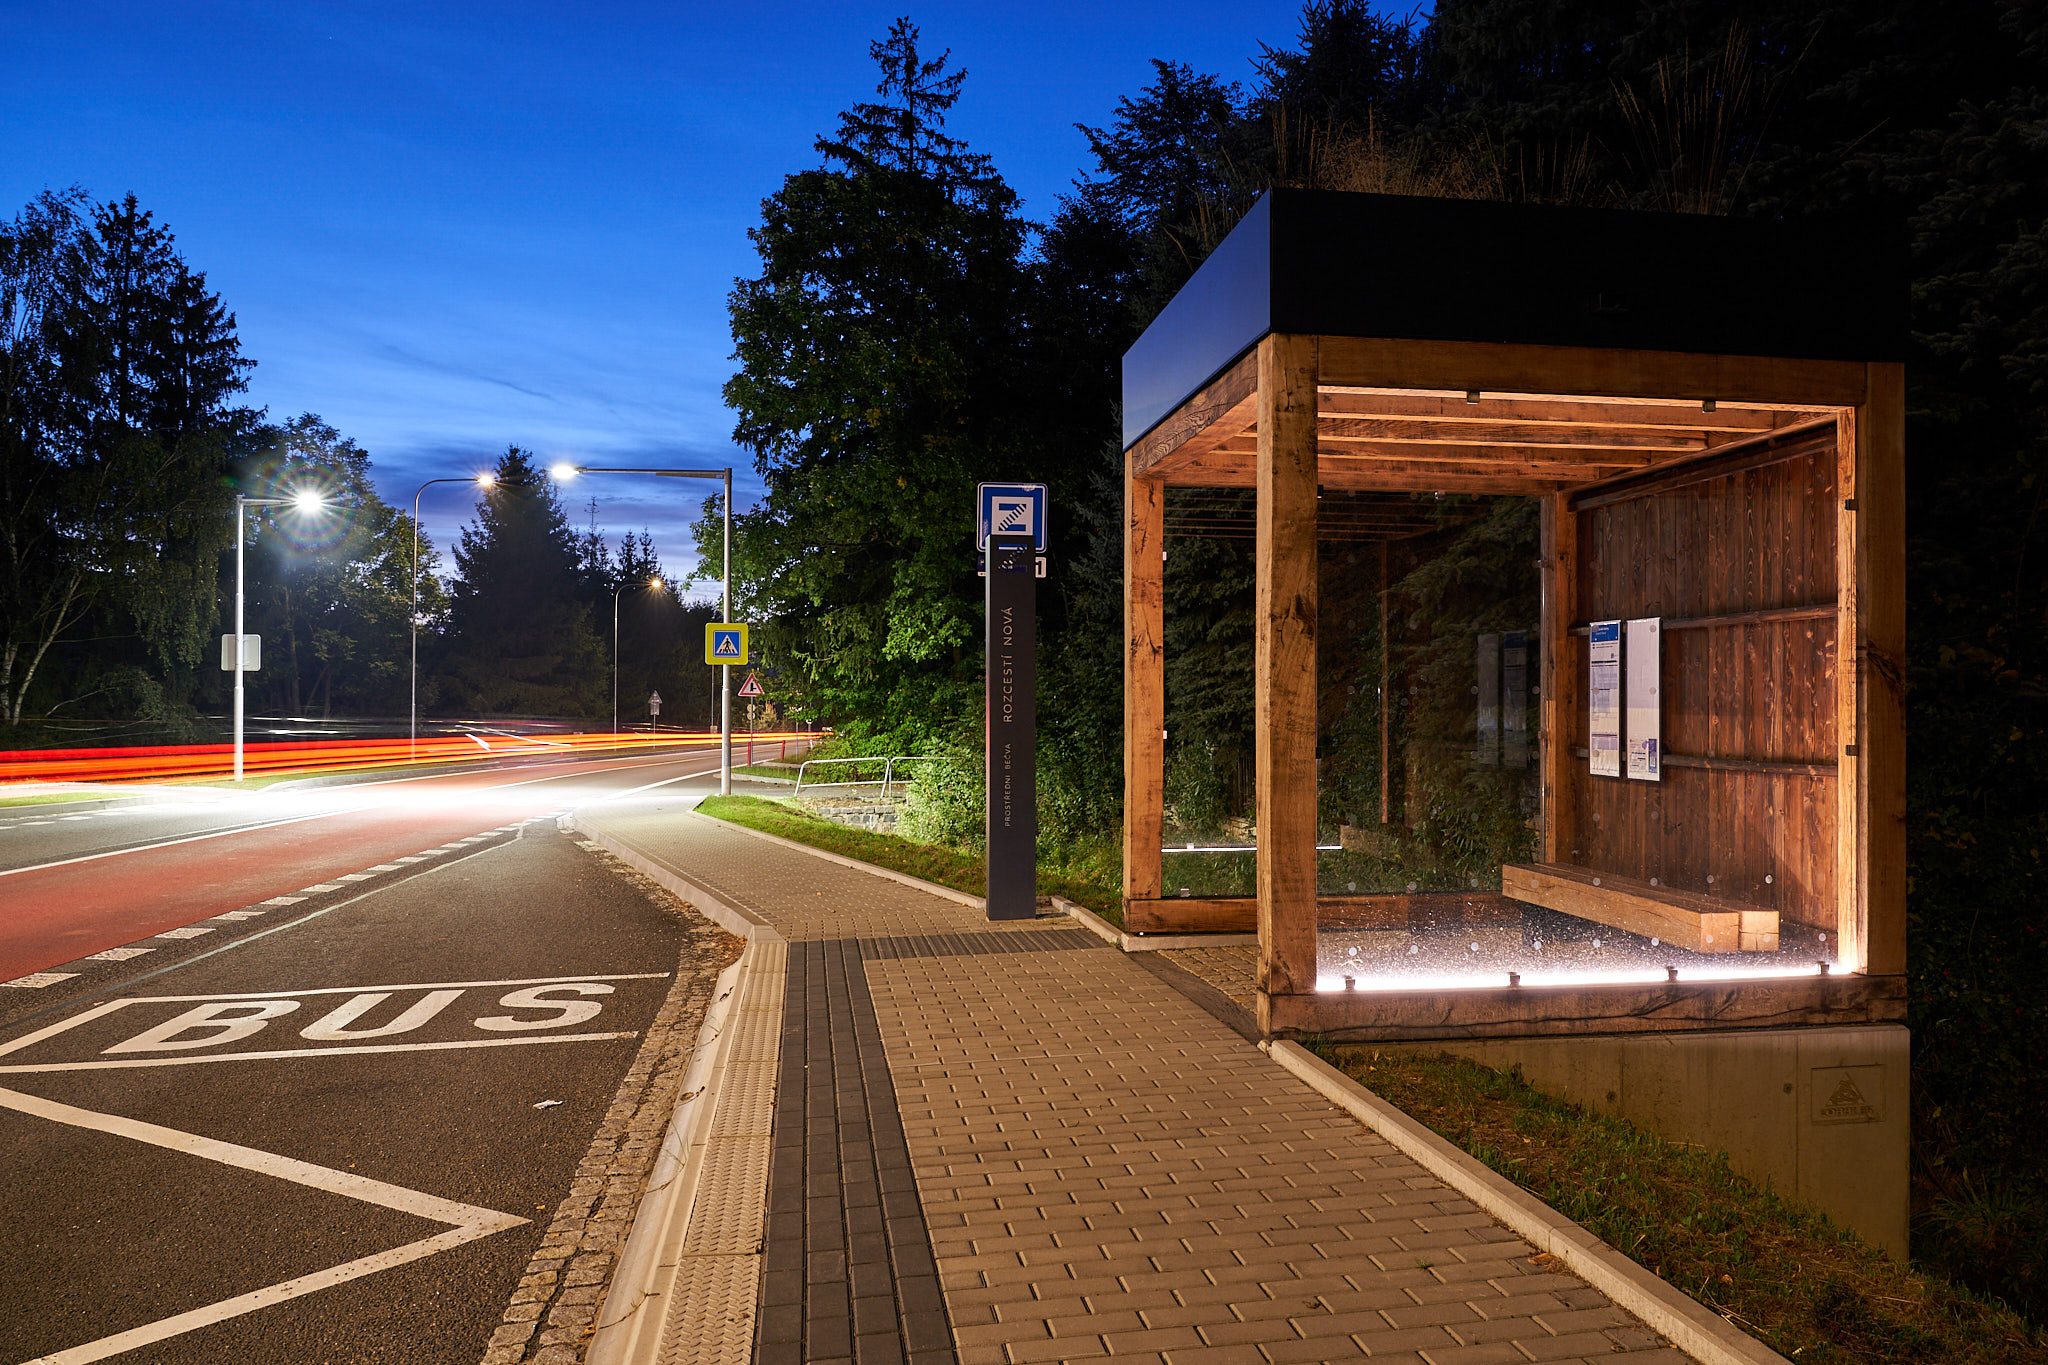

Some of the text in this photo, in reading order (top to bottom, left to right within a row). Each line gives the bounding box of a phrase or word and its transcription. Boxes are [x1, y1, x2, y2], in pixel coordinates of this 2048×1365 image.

[1001, 606, 1013, 723] ROZCESTÍ NOVÁ
[101, 982, 616, 1054] BUS
